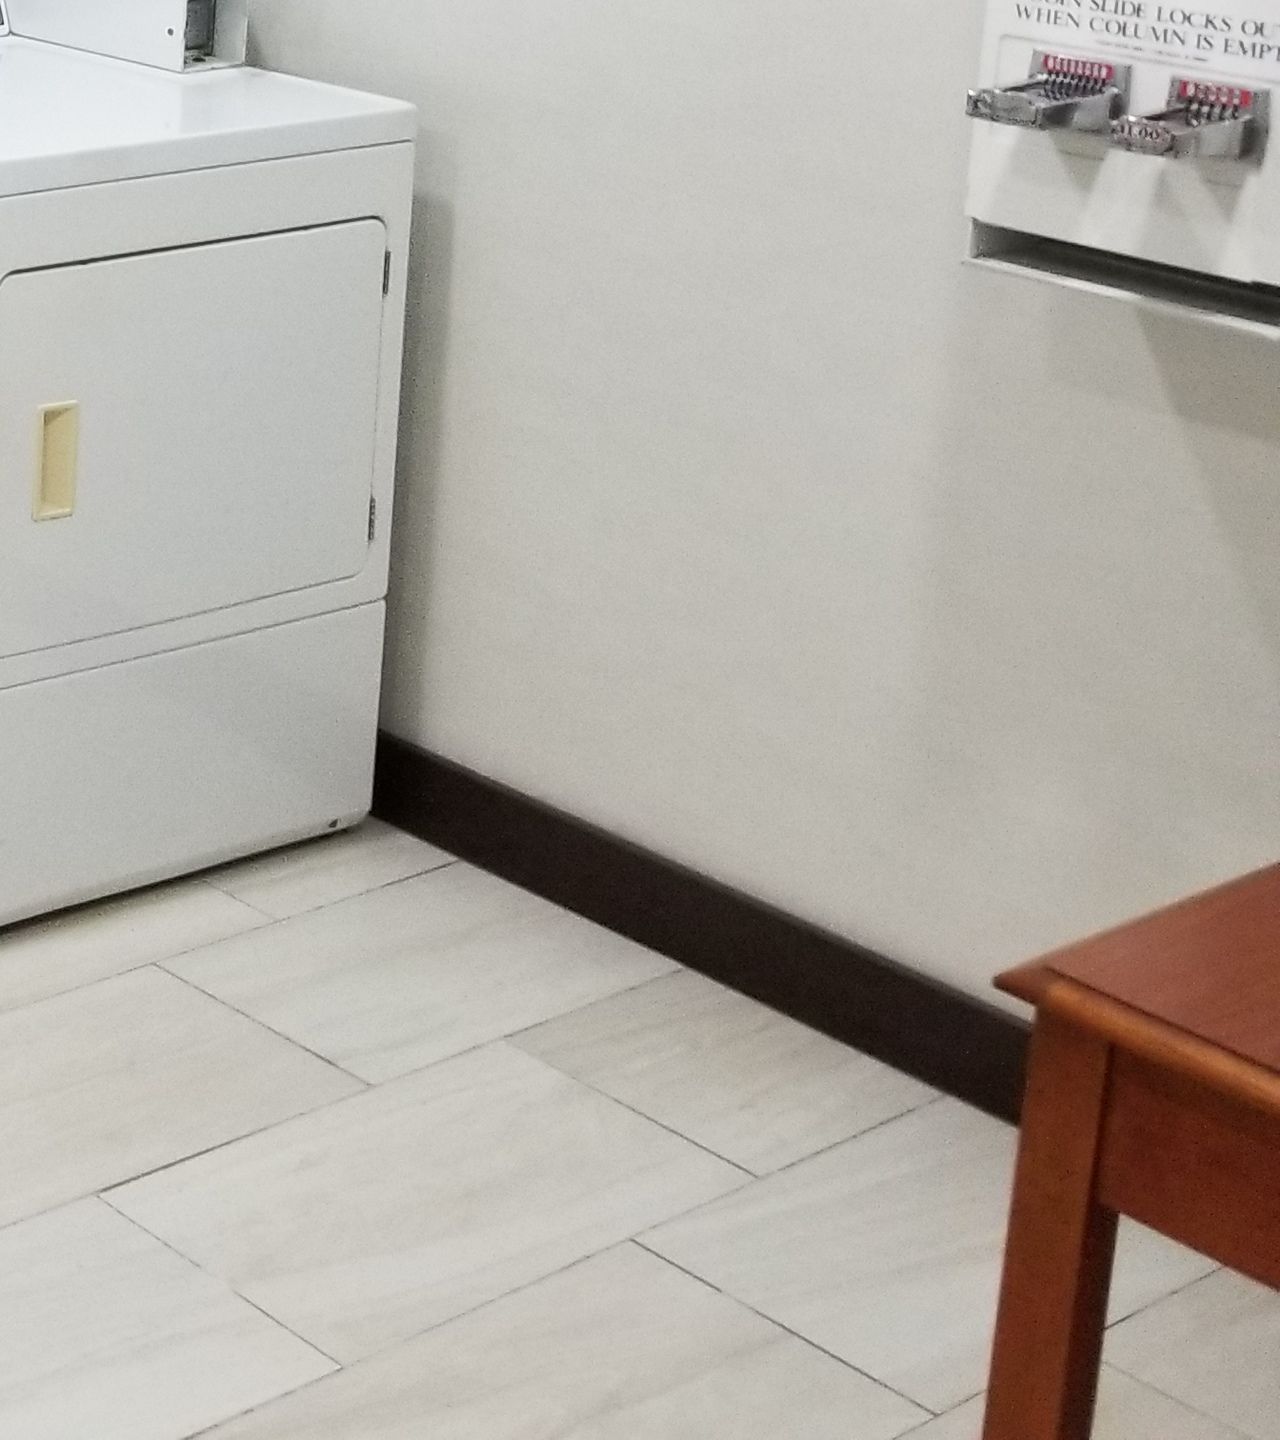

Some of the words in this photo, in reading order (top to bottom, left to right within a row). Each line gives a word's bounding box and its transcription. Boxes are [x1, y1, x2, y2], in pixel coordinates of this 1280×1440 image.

[1015, 2, 1080, 29] WHEN
[1089, 16, 1186, 47] COLUMN
[1195, 32, 1214, 50] IS
[1155, 4, 1232, 34] LOCKS
